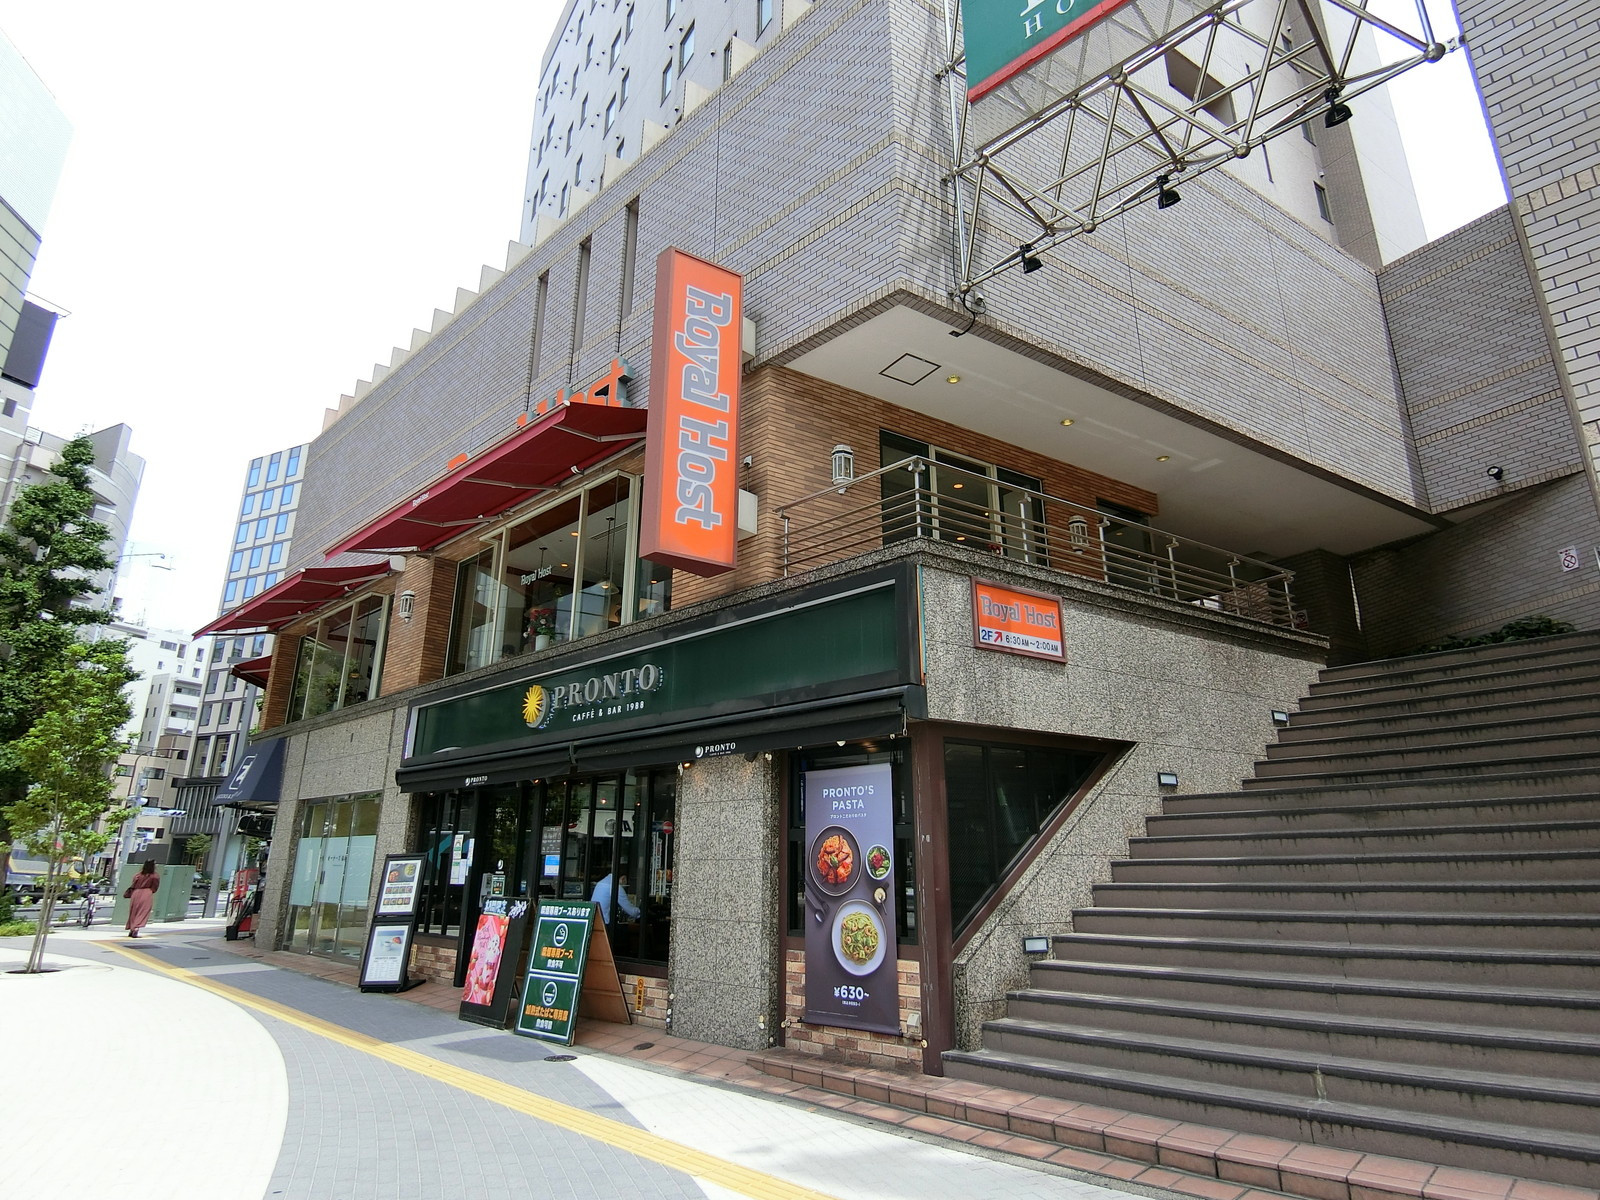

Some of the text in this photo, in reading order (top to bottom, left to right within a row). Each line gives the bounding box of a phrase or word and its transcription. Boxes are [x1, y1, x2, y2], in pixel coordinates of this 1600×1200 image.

[674, 285, 732, 531] Royal Host
[521, 565, 552, 586] Royal Host
[980, 594, 1057, 629] Royal Host
[980, 629, 993, 641] 2F
[554, 663, 659, 709] PRONTO
[598, 708, 603, 717] &
[607, 705, 622, 716] BAR
[626, 701, 645, 712] 1988
[704, 742, 736, 754] PRONTO
[822, 785, 874, 798] PRONTO'S
[832, 799, 864, 810] PASTA
